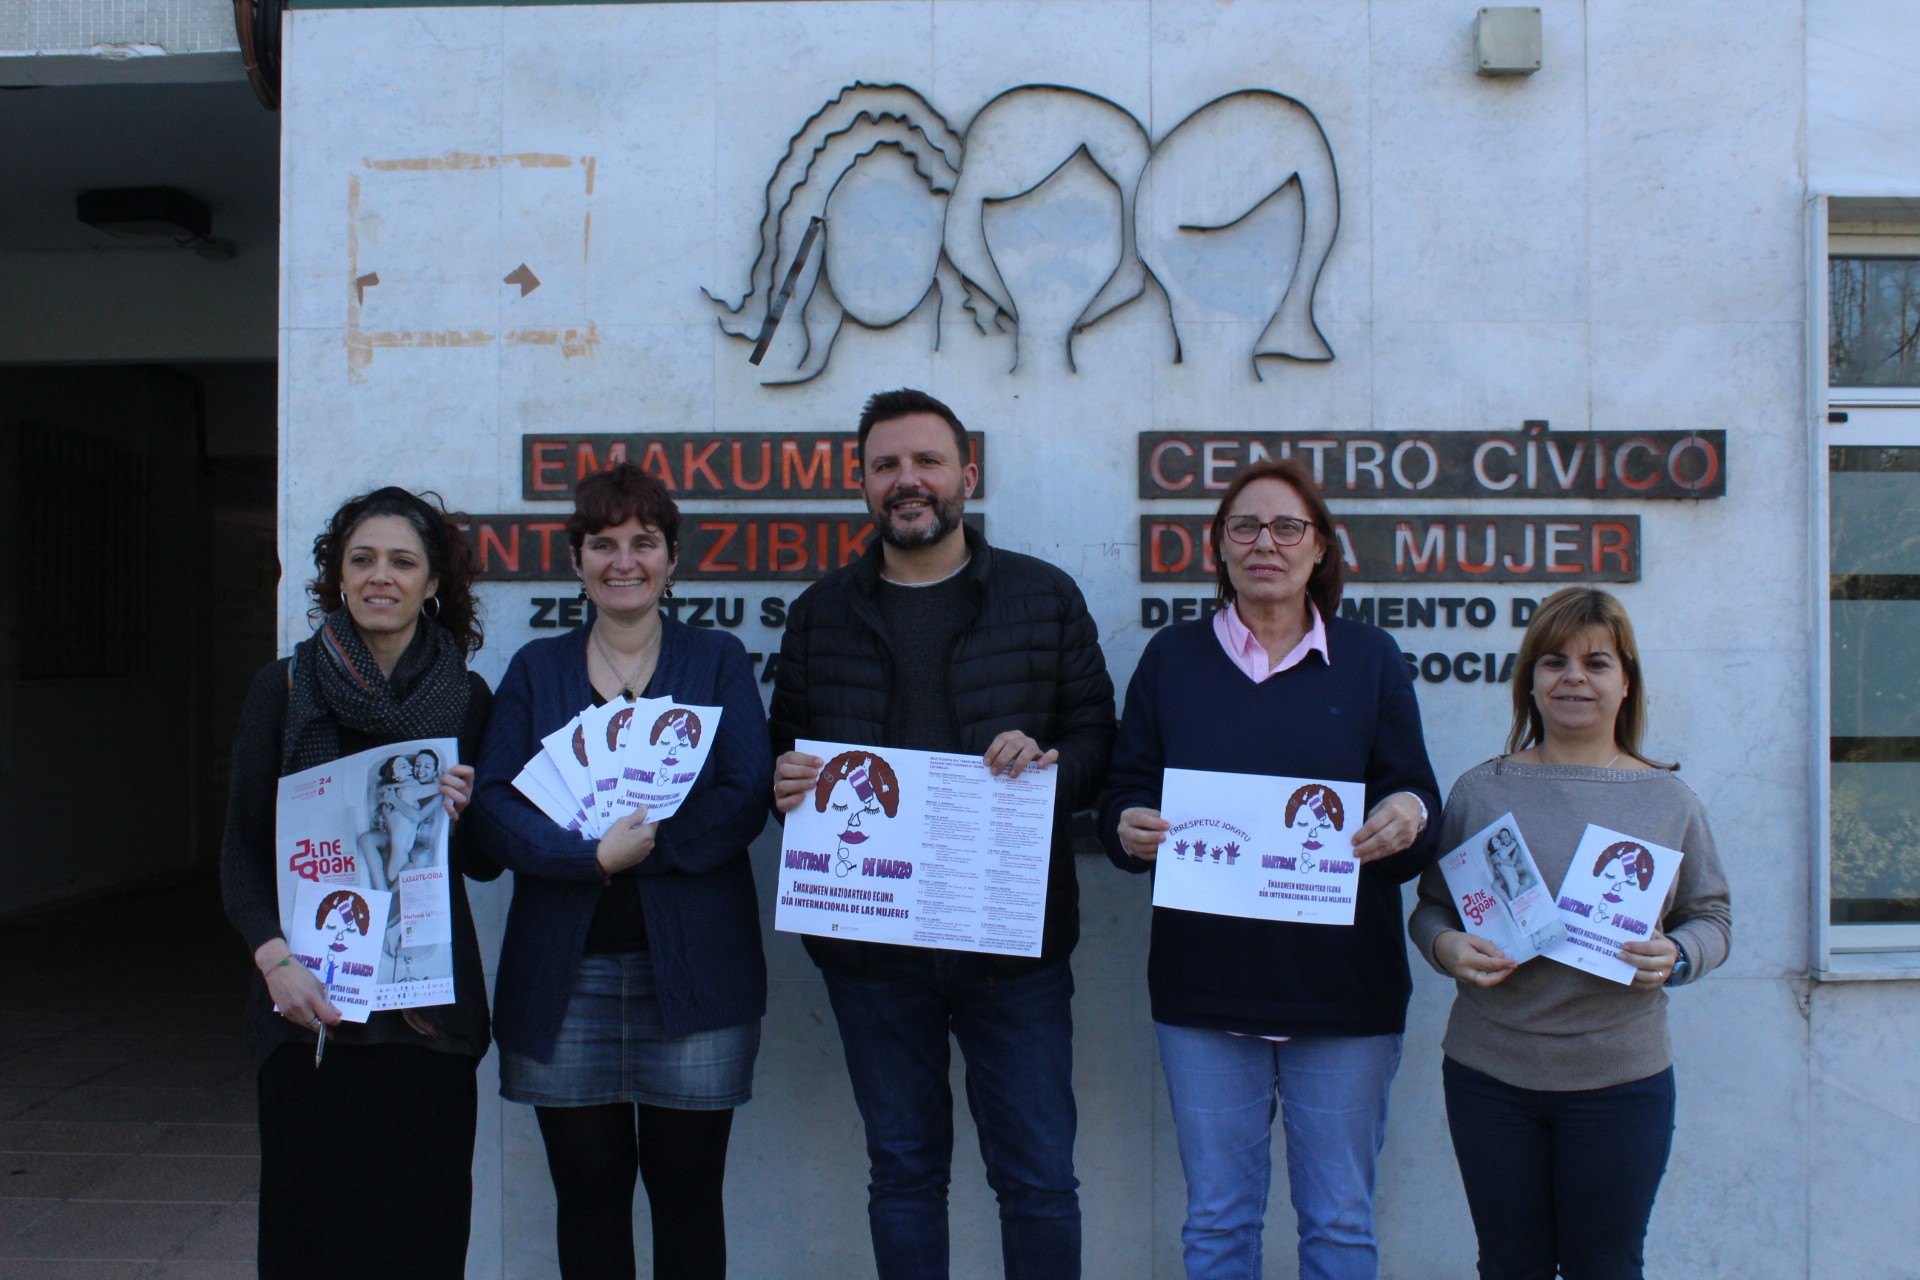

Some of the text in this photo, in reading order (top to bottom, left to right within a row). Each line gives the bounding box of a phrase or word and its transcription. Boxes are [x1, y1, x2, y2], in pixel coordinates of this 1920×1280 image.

[1473, 424, 1718, 490] CÍVICO
[1395, 522, 1631, 574] MUJER
[318, 787, 325, 795] 8
[319, 776, 332, 785] 24
[1169, 819, 1251, 842] ERRESPETUZ JOKATU
[862, 857, 875, 876] DE
[875, 859, 913, 879] MARZO
[793, 880, 894, 903] EMAKUMEEN NAZIOARTEKO EGUNA
[781, 891, 910, 919] DÍA INTERNACIONAL DE LAS MUJERES
